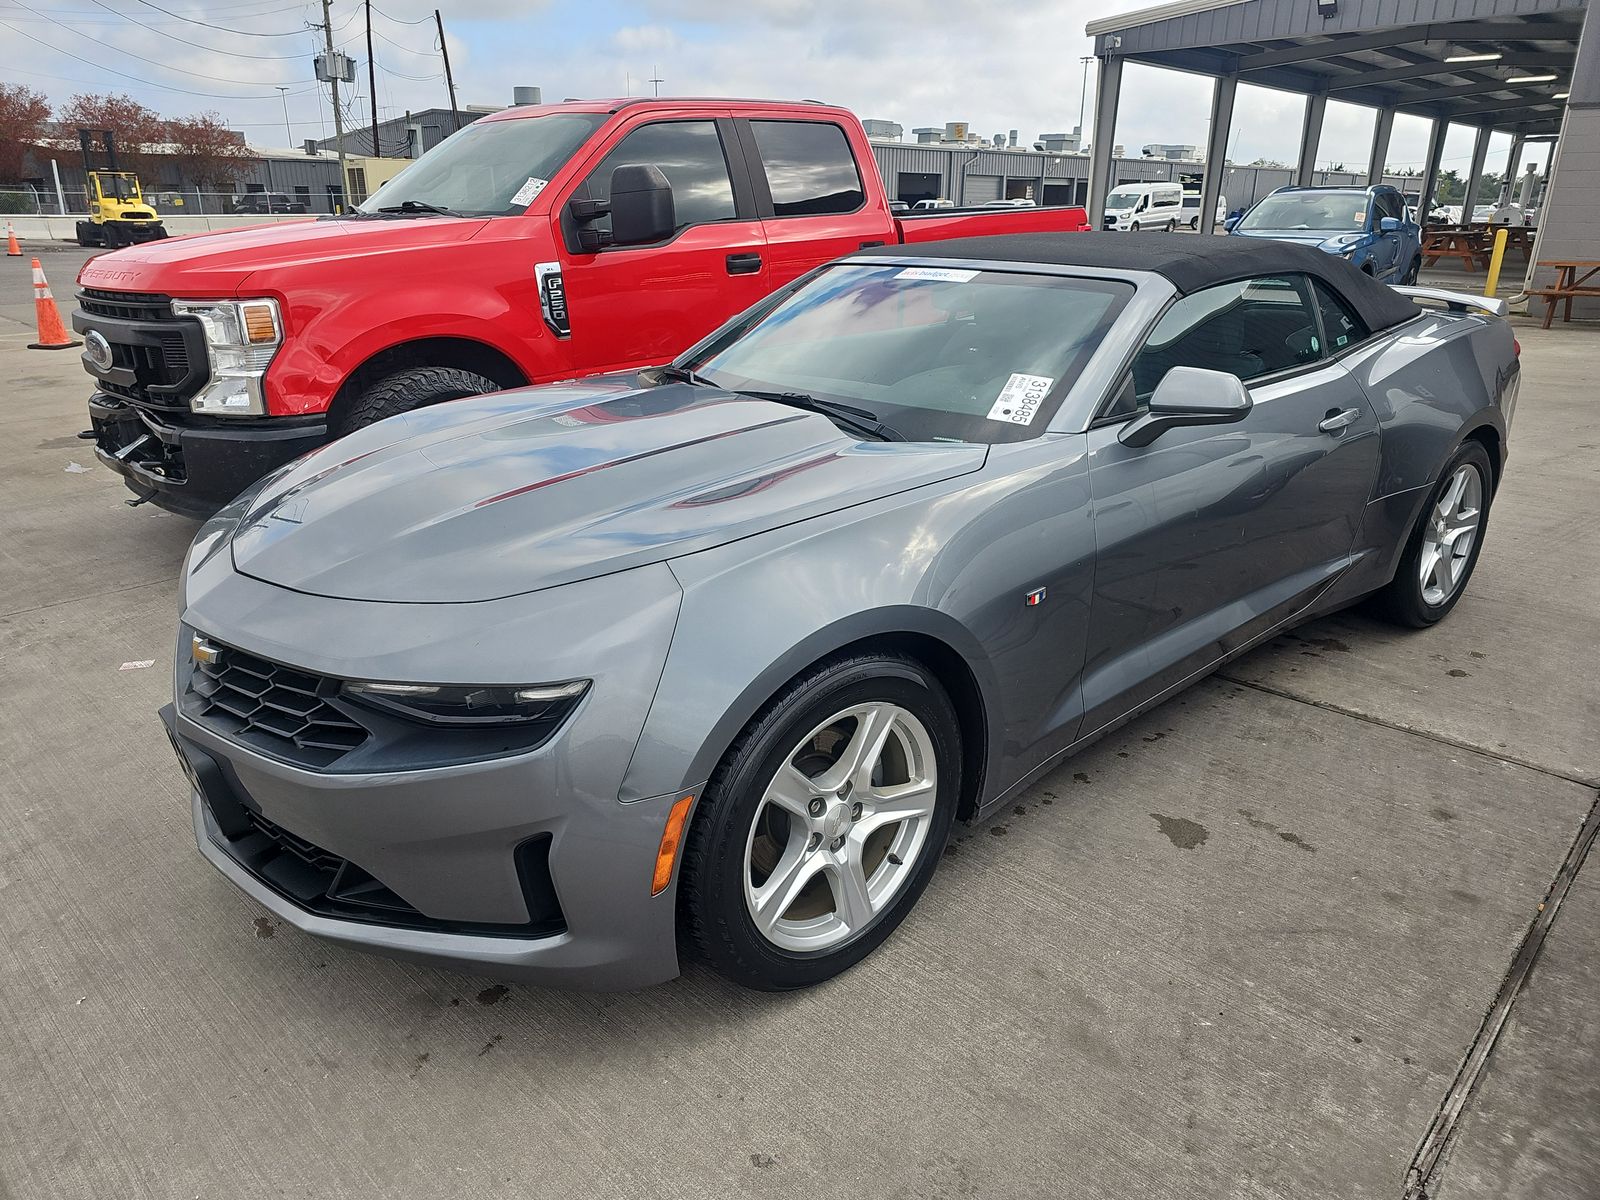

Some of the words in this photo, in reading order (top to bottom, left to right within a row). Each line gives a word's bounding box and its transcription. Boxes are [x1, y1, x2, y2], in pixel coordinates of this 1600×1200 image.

[103, 270, 142, 281] DUTY
[919, 270, 951, 279] budget
[1012, 381, 1047, 423] 3138485
